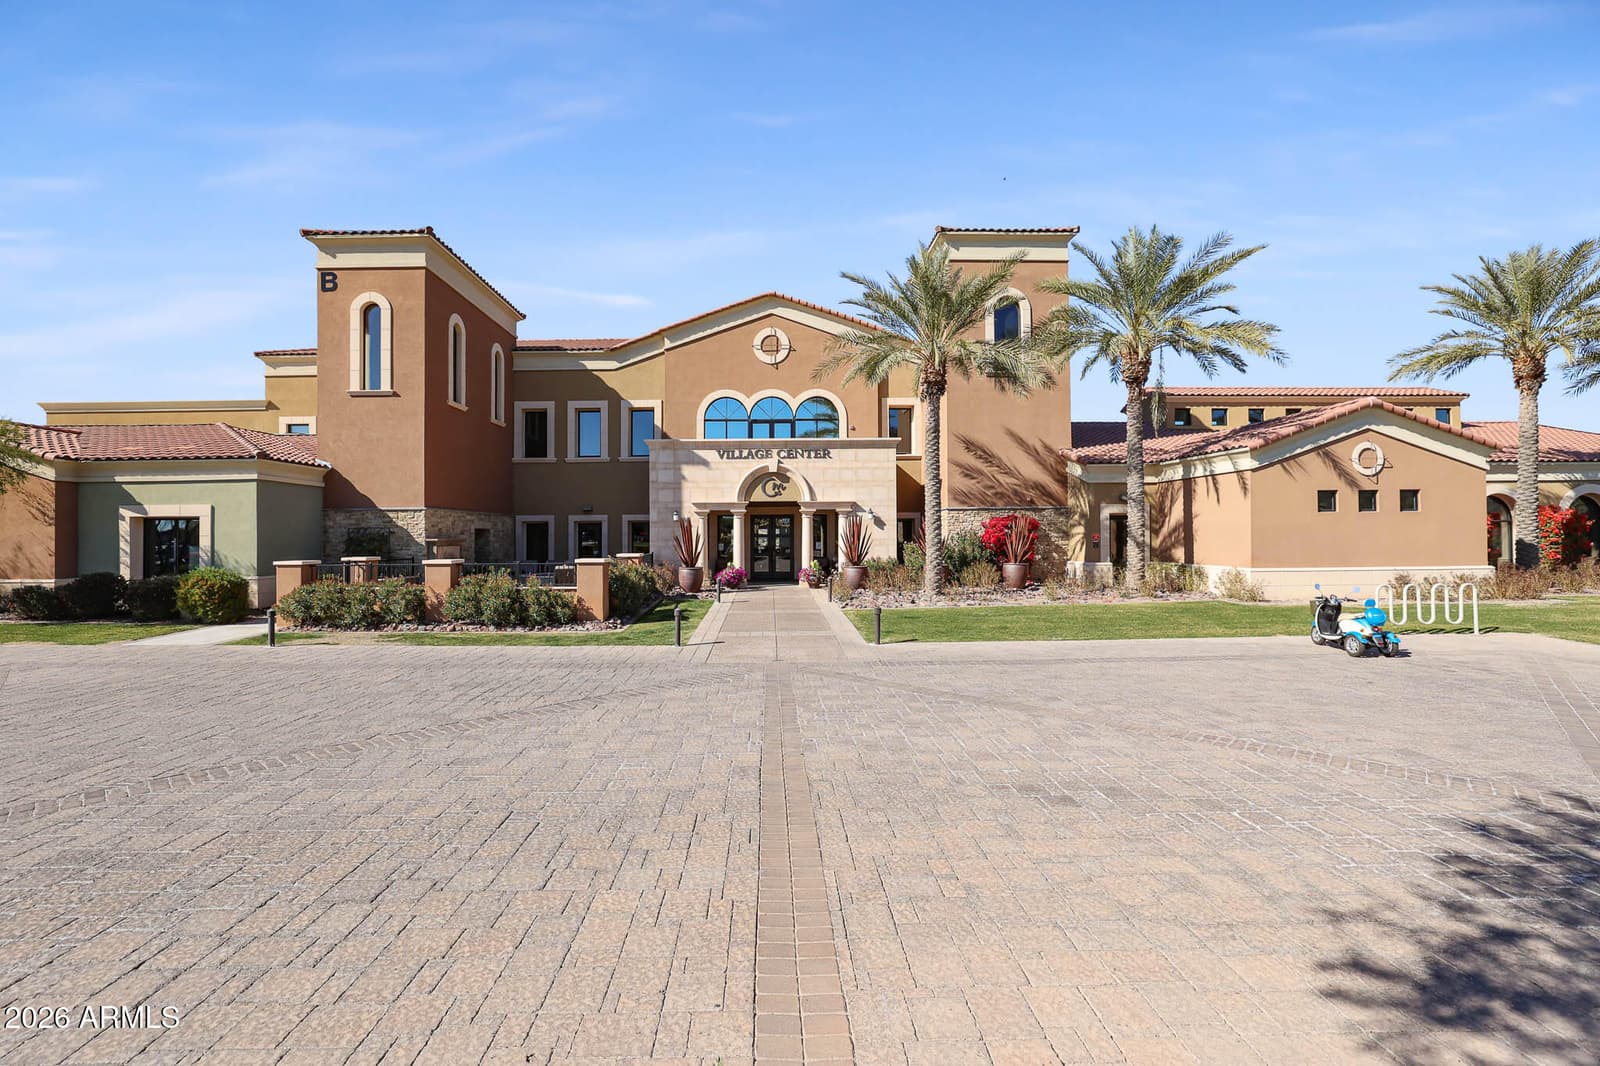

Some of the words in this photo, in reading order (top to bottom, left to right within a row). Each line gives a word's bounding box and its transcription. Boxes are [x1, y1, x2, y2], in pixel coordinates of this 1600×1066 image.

[320, 271, 338, 292] B
[717, 449, 773, 460] VILLAGE
[776, 449, 832, 460] CENTER
